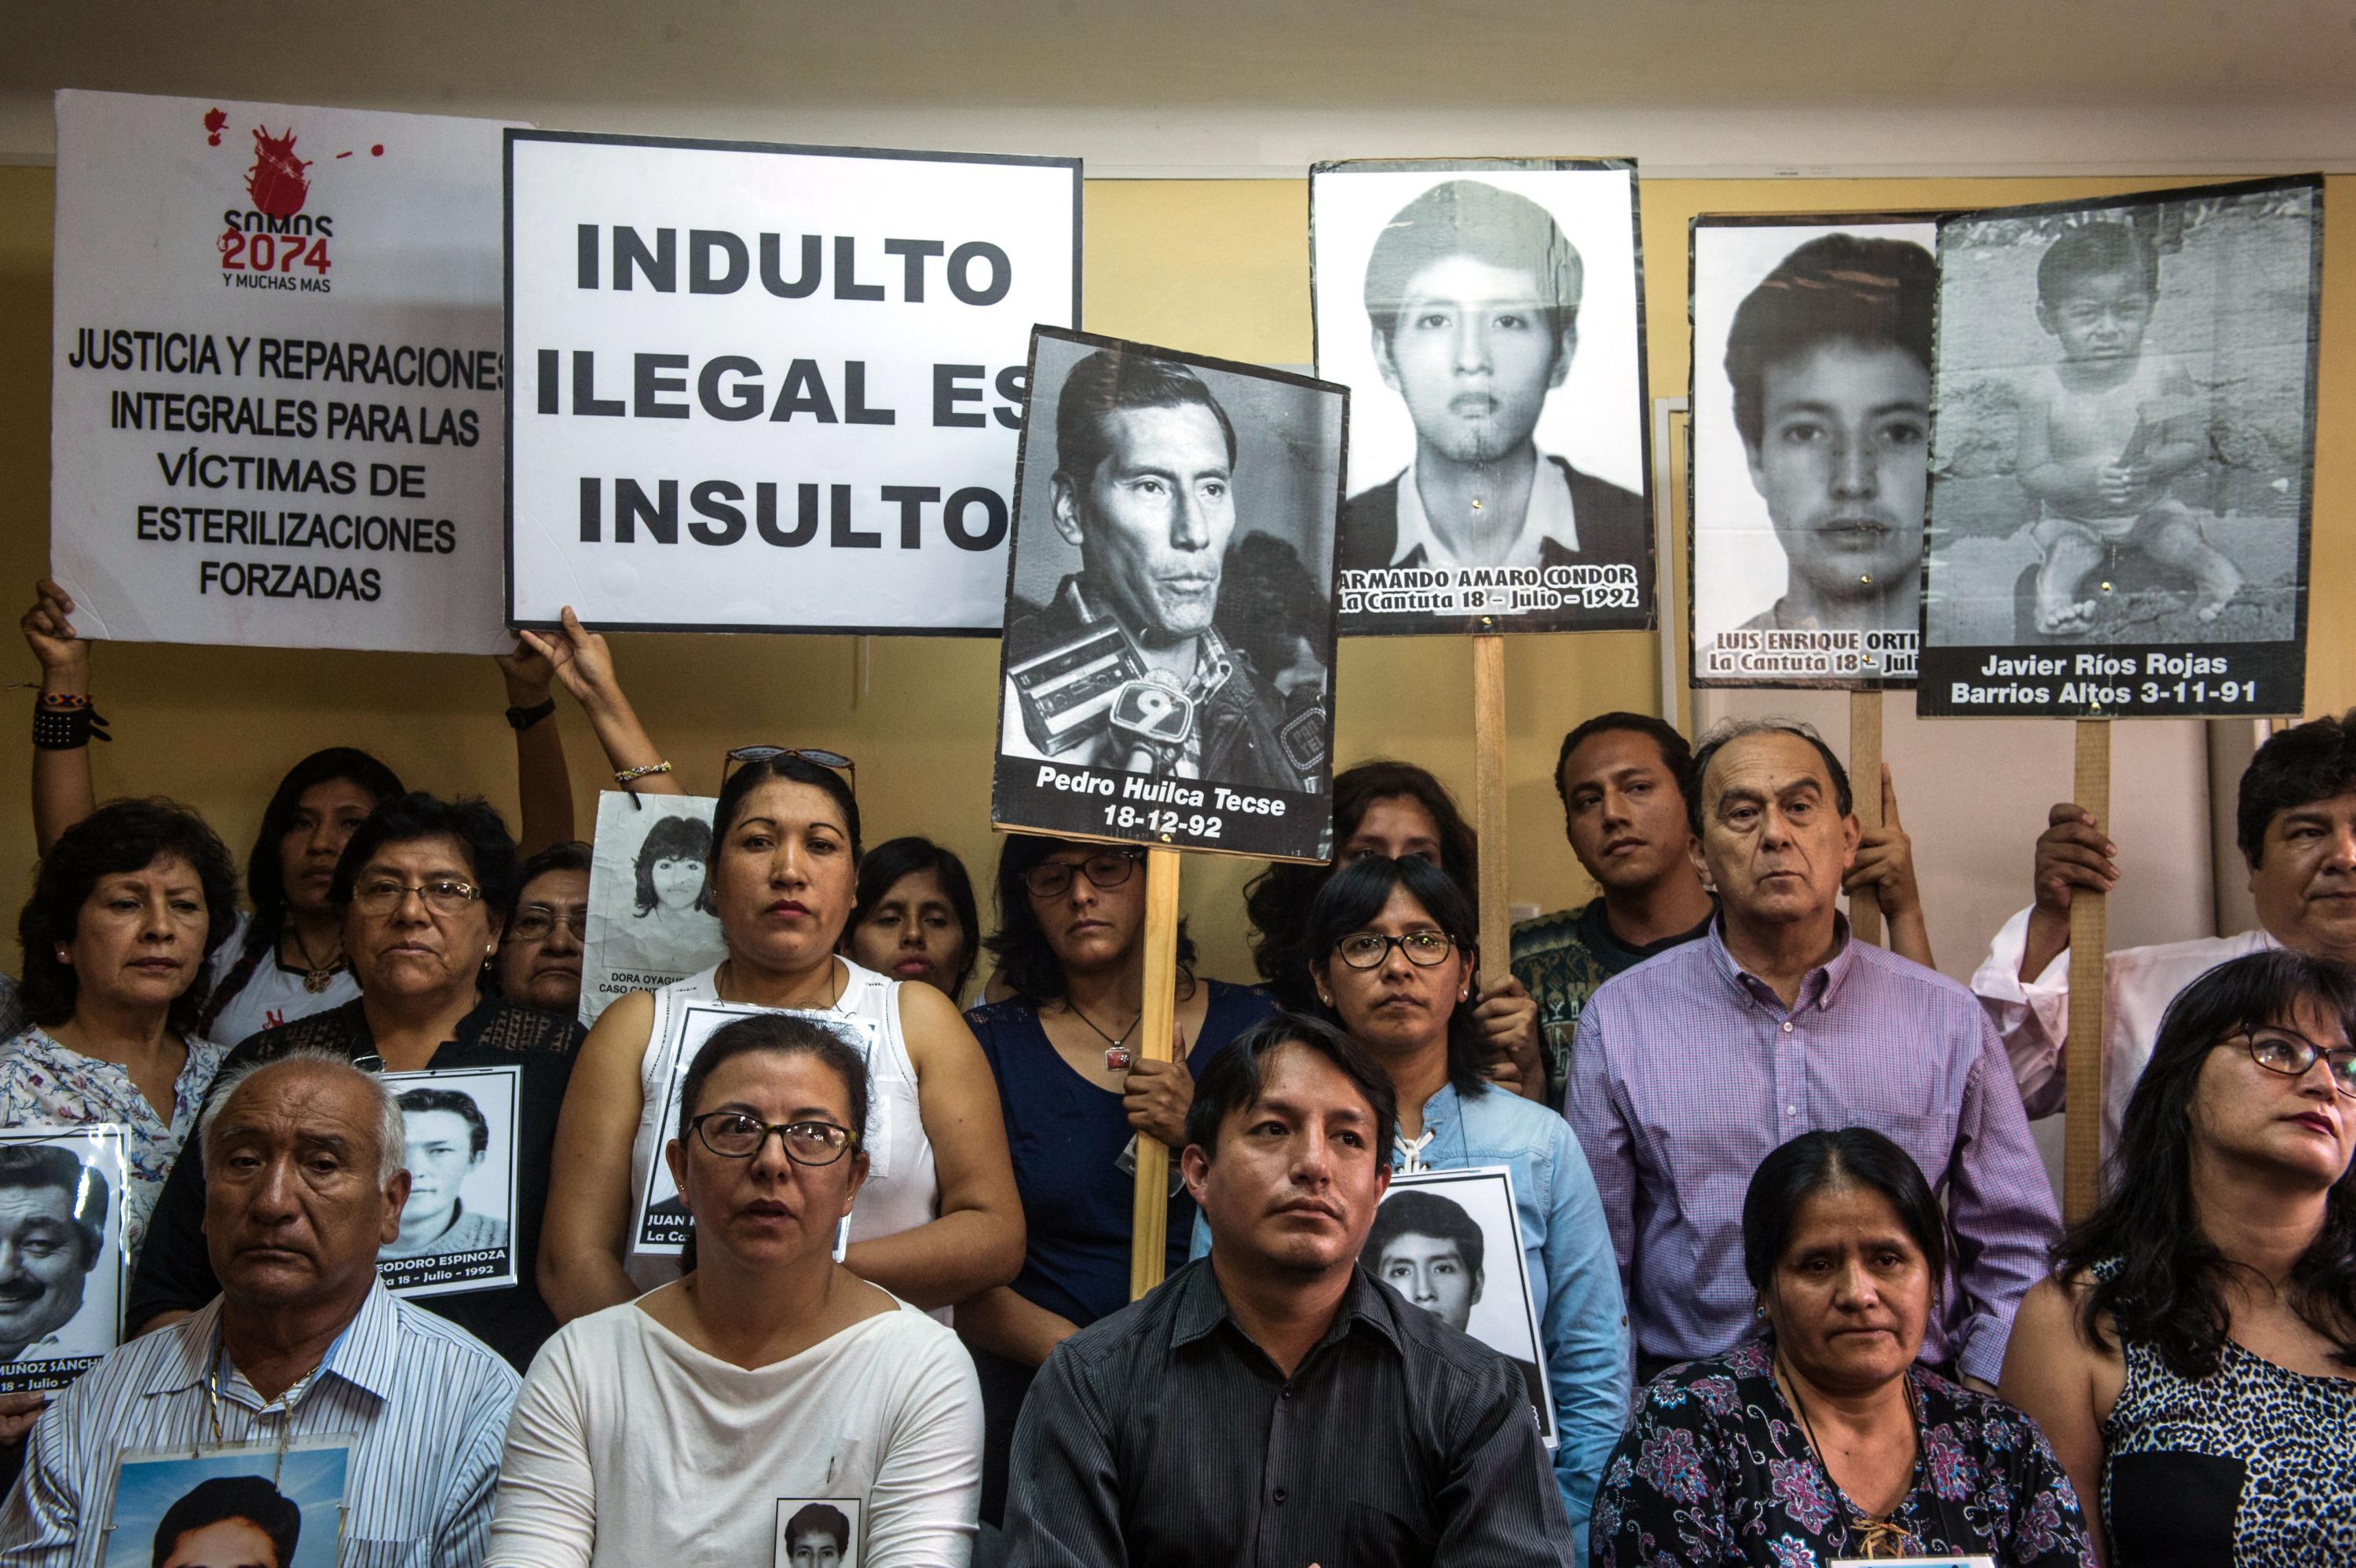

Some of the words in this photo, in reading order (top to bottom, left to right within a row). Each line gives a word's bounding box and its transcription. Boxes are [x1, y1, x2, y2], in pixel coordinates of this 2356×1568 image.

[221, 230, 331, 275] 2074
[577, 223, 1012, 306] INDULTO
[223, 273, 232, 287] Y
[236, 275, 296, 291] MUCHAS
[301, 278, 331, 293] MAS
[69, 327, 221, 375] JUSTICIA
[226, 337, 251, 377] Y
[259, 338, 503, 392] REPARACIONE
[537, 349, 895, 426] ILEGAL
[111, 390, 317, 438] INTEGRALES
[327, 401, 413, 444] PARA
[419, 408, 479, 447] LAS
[158, 446, 357, 495] VÍCTIMAS
[371, 463, 426, 499] DE
[580, 477, 1009, 552] INSULTO
[137, 506, 455, 555] ESTERILIZACIONES
[199, 561, 382, 601] FORZADAS
[1341, 571, 1450, 590] ARMANDO
[1458, 569, 1538, 587] AMARO
[1547, 568, 1635, 585] CONDOR
[1368, 593, 1454, 610] Cantuta
[1462, 591, 1484, 608] 18
[1509, 590, 1559, 609] Julio
[1585, 588, 1636, 605] 1992
[1717, 633, 1760, 650] LUIS
[1768, 633, 1859, 652] ENRIQUE
[1710, 654, 1732, 670] La
[1741, 654, 1827, 671] Cantuta
[1836, 654, 1858, 671] 18
[1981, 655, 2067, 676] Javier
[2076, 653, 2137, 676] Ríos
[2146, 652, 2228, 678] Rojas
[1951, 682, 2051, 704] Barrios
[2058, 682, 2131, 704] Altos
[2140, 681, 2255, 704] 3-11-91
[1036, 766, 1115, 796] Pedro
[1122, 777, 1205, 807] Huilca
[1214, 788, 1286, 817] Tecse
[1104, 804, 1223, 839] 18-12-92
[599, 984, 627, 994] CASO
[611, 973, 640, 983] DORA
[647, 1215, 685, 1226] JUAN
[646, 1230, 664, 1241] La
[439, 1249, 506, 1266] ESPINOZA
[398, 1275, 411, 1285] 18
[423, 1270, 452, 1283] Julio
[465, 1265, 494, 1277] 1992
[50, 1358, 101, 1372] SÁNCH
[2, 1381, 14, 1391] 18
[28, 1377, 58, 1390] Julio
